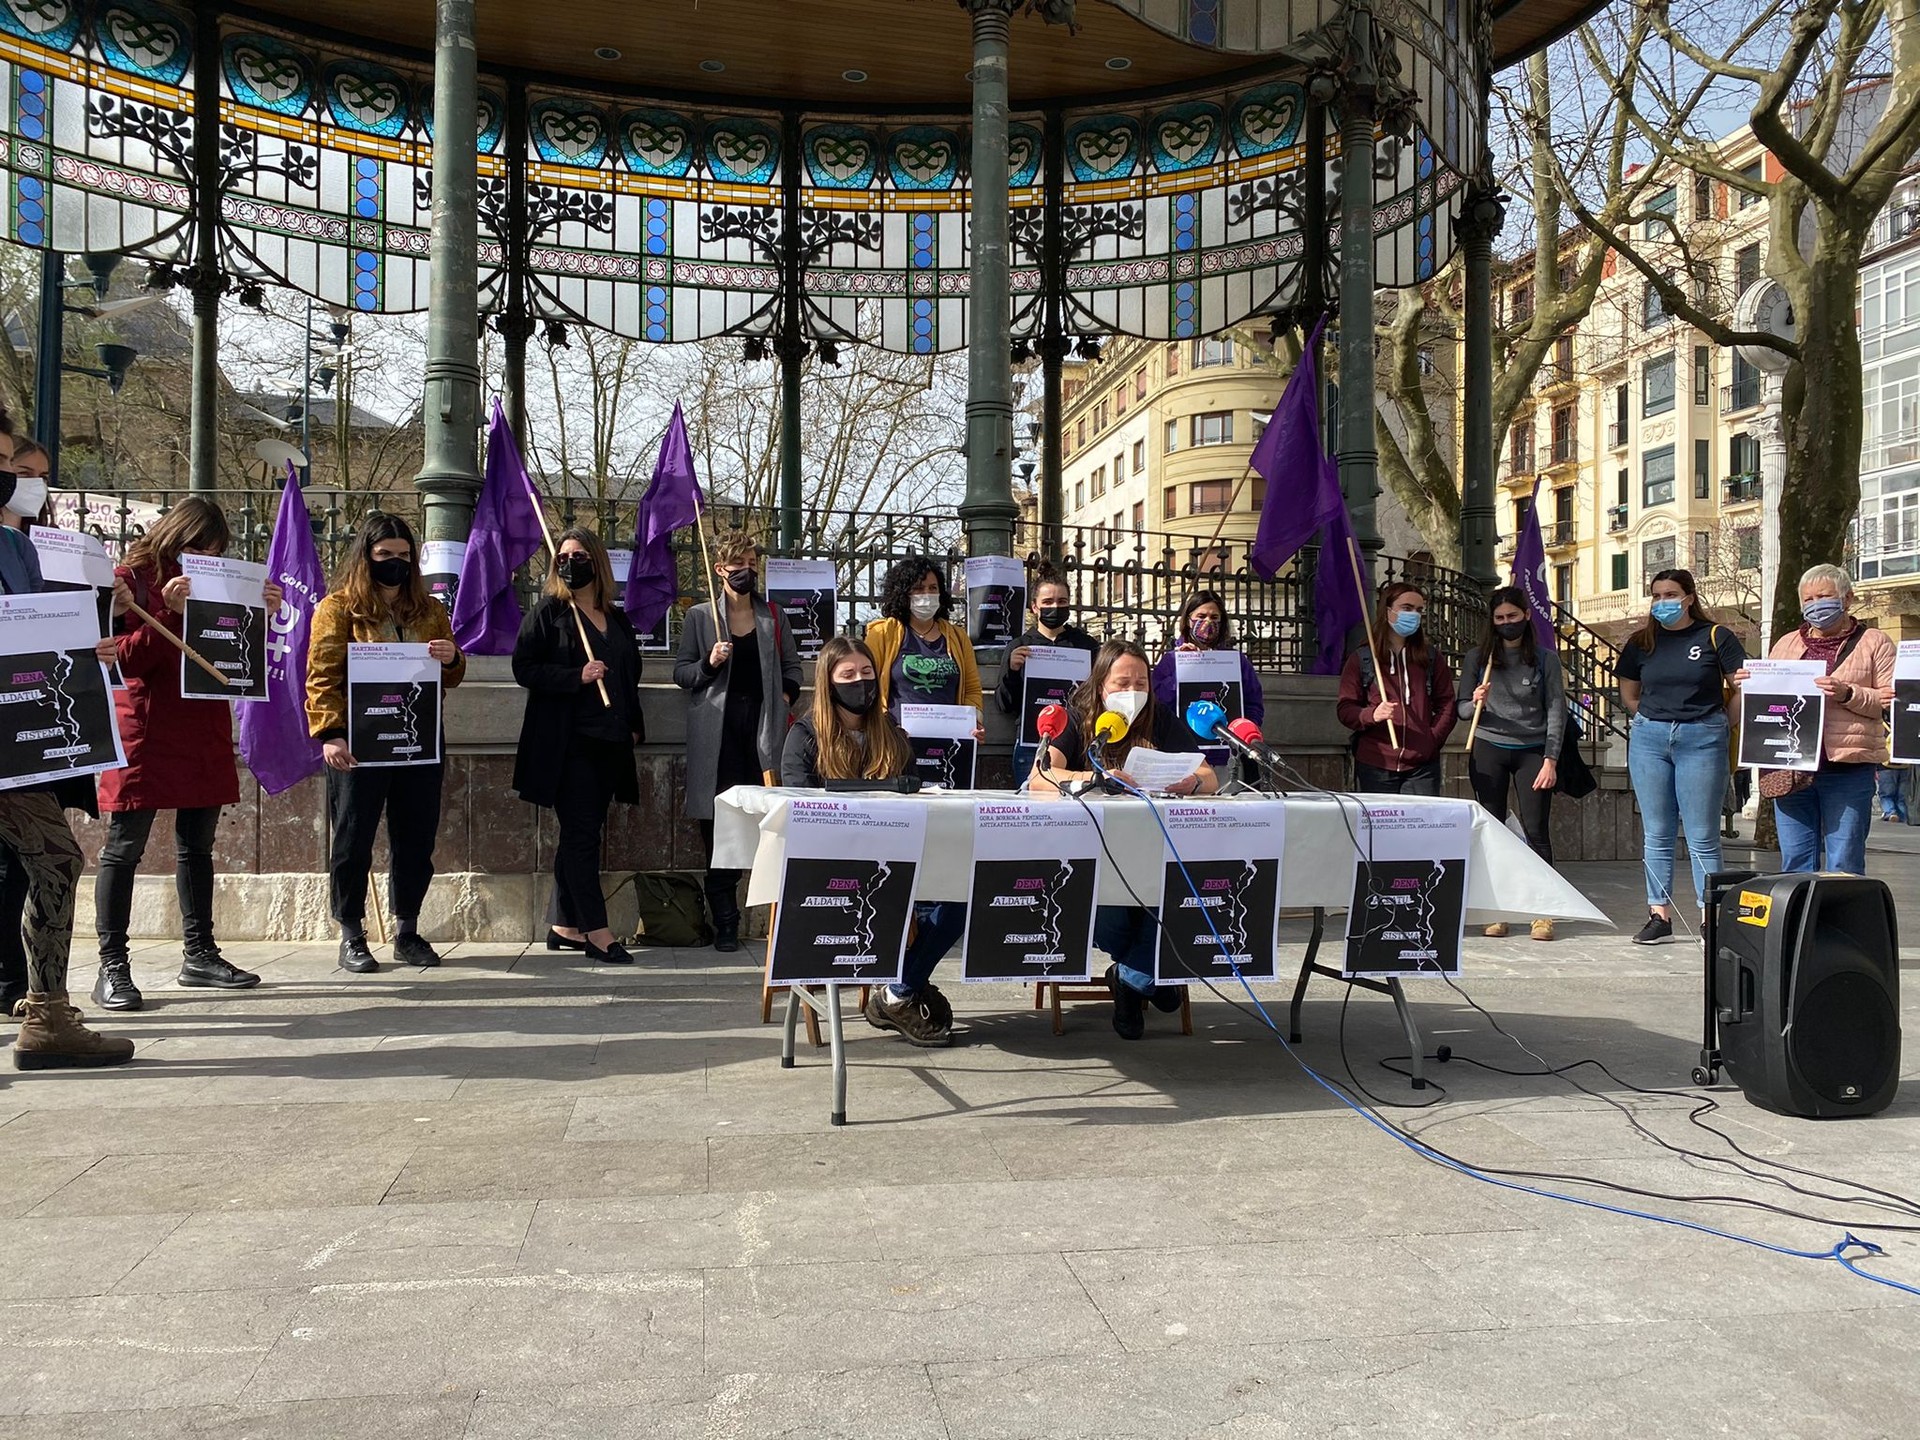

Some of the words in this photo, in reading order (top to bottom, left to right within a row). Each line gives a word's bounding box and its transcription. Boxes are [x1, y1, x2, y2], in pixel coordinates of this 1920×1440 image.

[186, 559, 220, 567] MARTXOAK
[203, 630, 233, 639] ALDATU
[13, 671, 45, 683] DENA
[17, 727, 64, 740] SISTEMA
[793, 801, 839, 810] MARTXOAK
[980, 806, 1022, 814] MARTXOAK
[839, 812, 871, 820] FEMINISTA,
[1169, 808, 1209, 816] MARTXOAK
[1212, 808, 1216, 816] 8
[830, 879, 859, 888] DENA
[1016, 879, 1044, 889] DENA
[1204, 879, 1230, 889] DENA
[1393, 879, 1419, 888] DENA
[805, 896, 847, 906] ALDATU
[994, 896, 1032, 906] ALDATU
[815, 935, 858, 945] SISTEMA
[1005, 934, 1045, 943] SISTEMA
[1195, 935, 1233, 945] SISTMA
[1383, 932, 1420, 940] SISTMA
